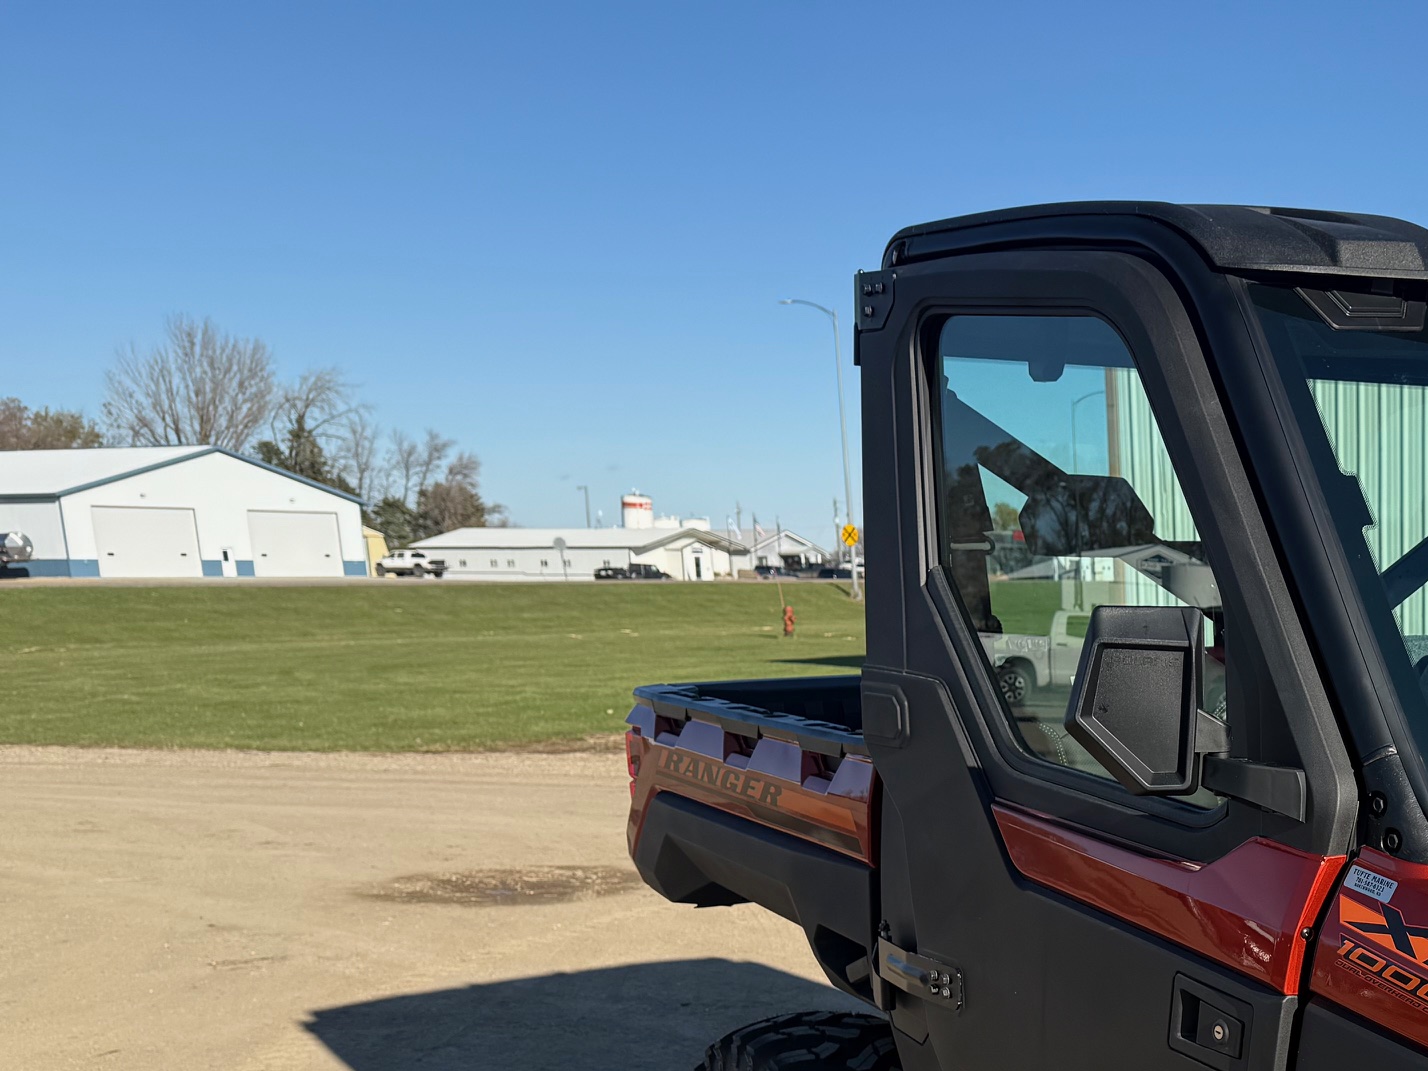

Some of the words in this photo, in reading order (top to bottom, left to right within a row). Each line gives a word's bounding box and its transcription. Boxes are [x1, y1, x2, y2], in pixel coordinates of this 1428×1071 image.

[664, 750, 783, 807] RANGER
[1371, 875, 1395, 889] MARINE
[1335, 959, 1421, 1009] DUAL-OVERHEAD
